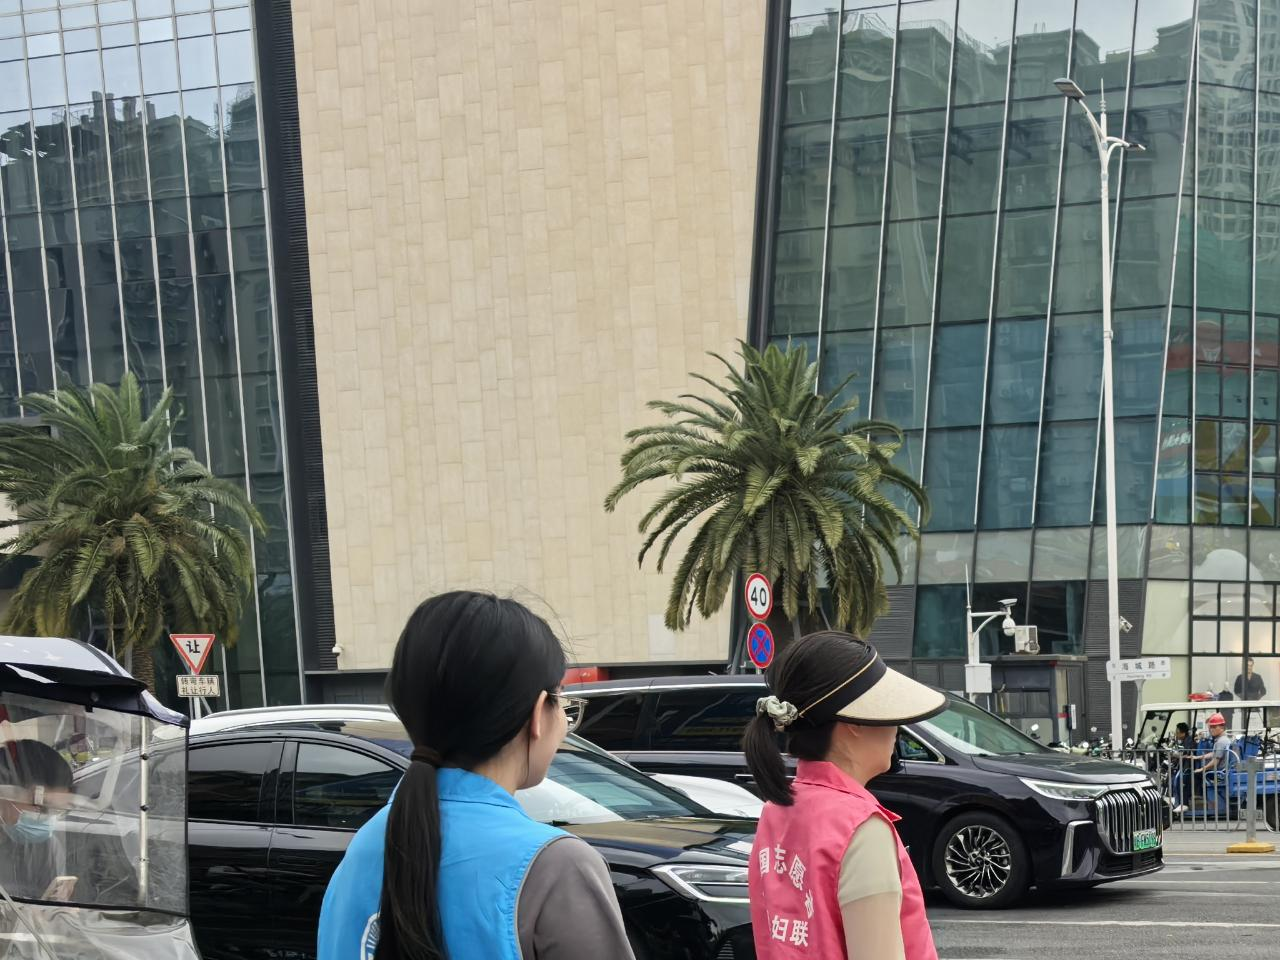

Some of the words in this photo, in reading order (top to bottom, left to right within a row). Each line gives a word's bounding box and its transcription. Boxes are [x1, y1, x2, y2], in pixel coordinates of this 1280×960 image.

[750, 587, 768, 607] 40
[186, 639, 201, 654] 让
[180, 686, 216, 695] 礼让行人
[767, 910, 809, 947] 妇联
